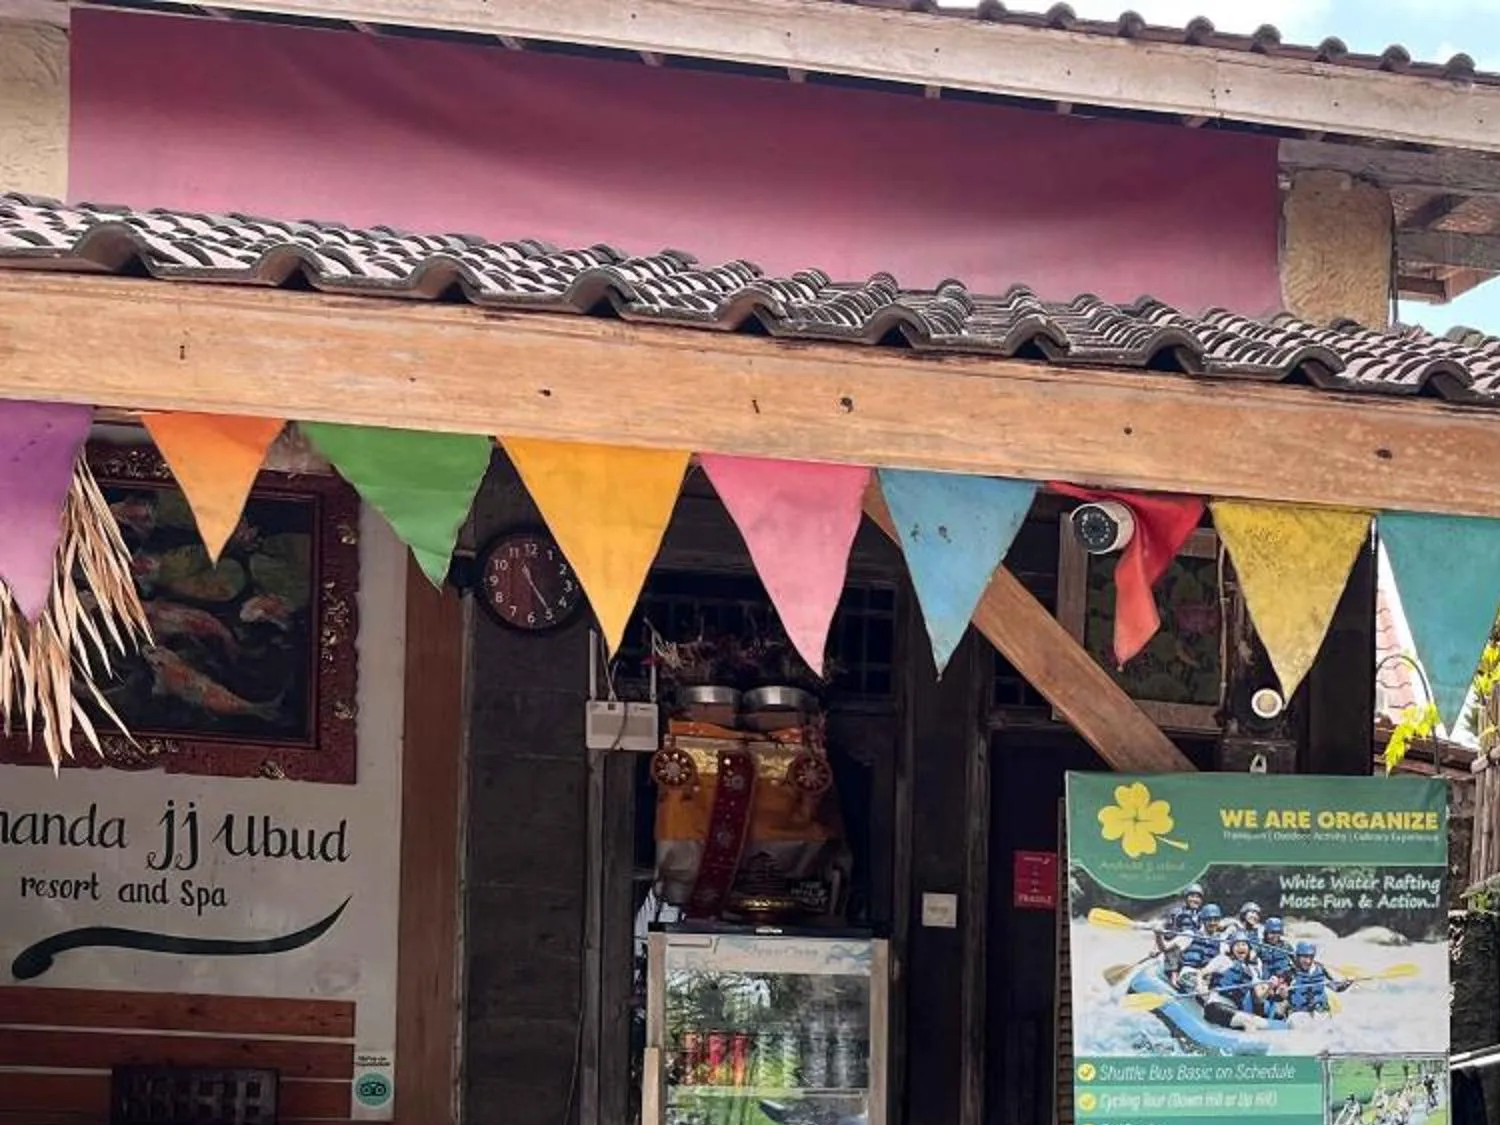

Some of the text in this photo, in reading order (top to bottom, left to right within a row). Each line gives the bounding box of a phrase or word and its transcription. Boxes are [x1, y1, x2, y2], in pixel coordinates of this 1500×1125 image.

[1219, 808, 1438, 831] WE ARE ORGANIZE
[211, 813, 351, 862] Ubud
[20, 872, 228, 916] resort and Spa
[1279, 873, 1441, 895] White Water Rafting
[1279, 893, 1319, 908] Most
[1323, 894, 1353, 908] Fun
[1358, 894, 1373, 908] &
[1100, 1063, 1297, 1082] Shuttle Bus Basic on Schedule
